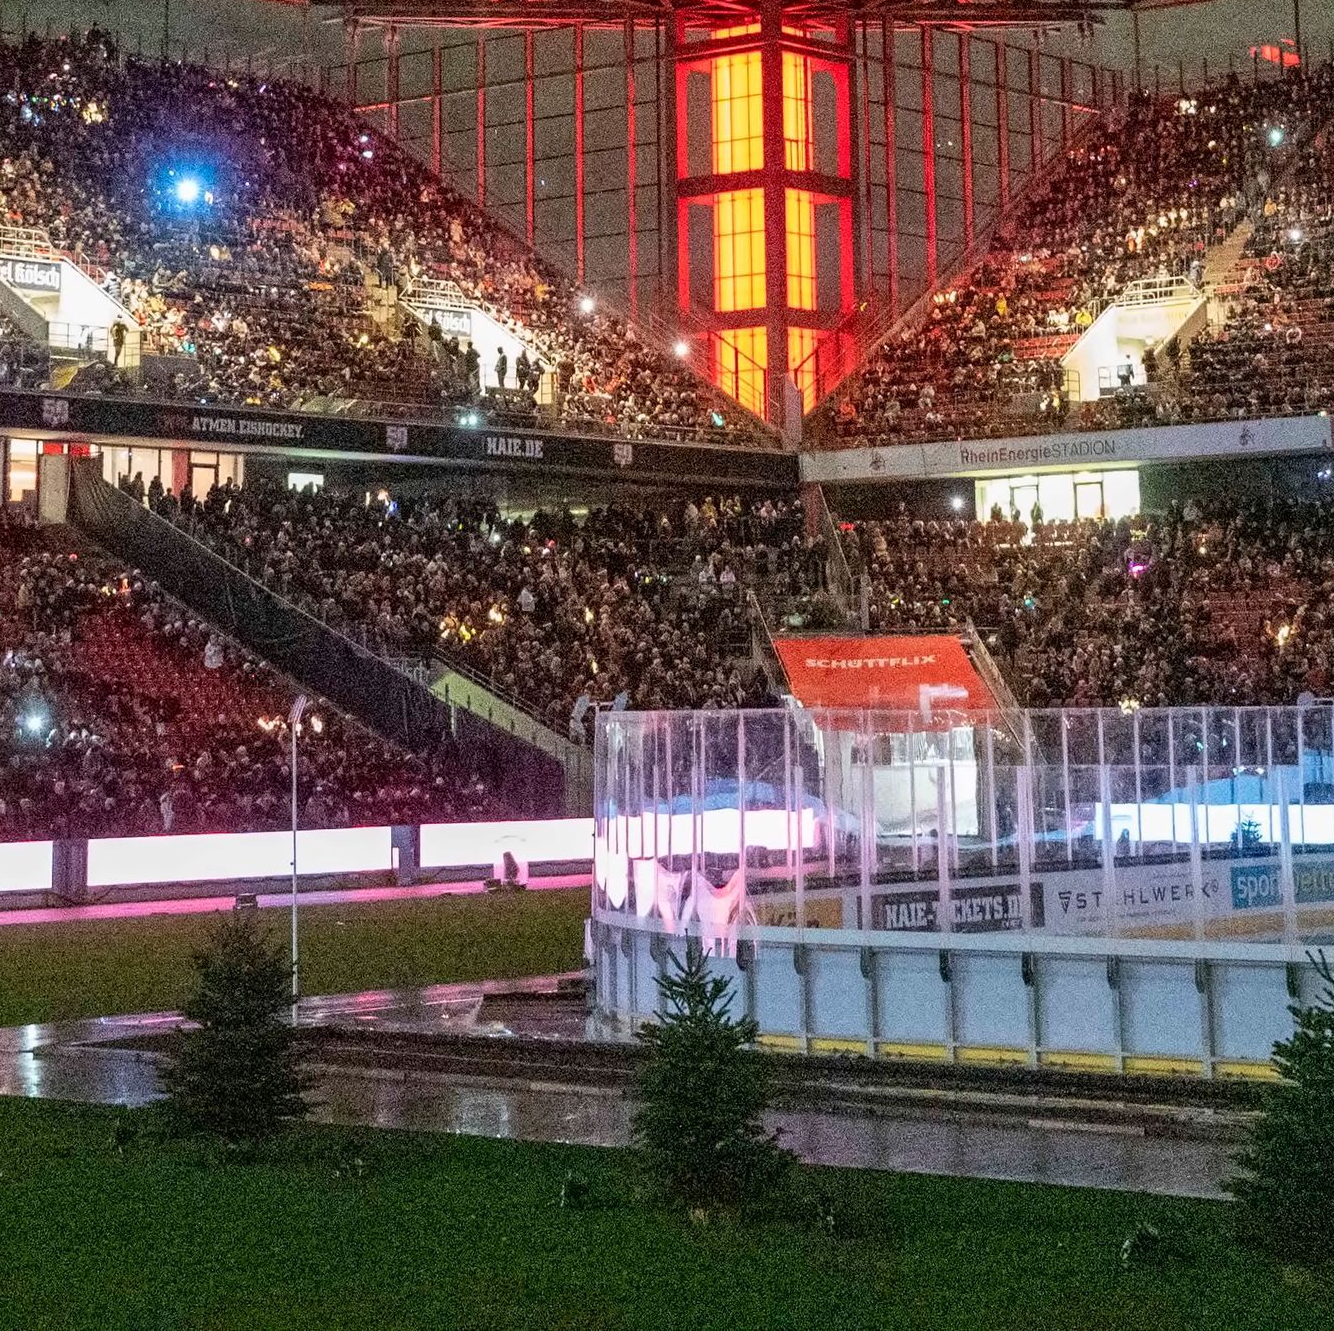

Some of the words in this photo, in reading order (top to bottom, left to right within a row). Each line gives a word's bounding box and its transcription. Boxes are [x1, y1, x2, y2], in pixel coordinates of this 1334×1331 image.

[486, 436, 544, 459] HAIE.DE
[960, 439, 1116, 465] RheinEnergieSTADION
[1076, 881, 1212, 910] STHLWERK
[885, 895, 1025, 930] HAIE-CKETS.D
